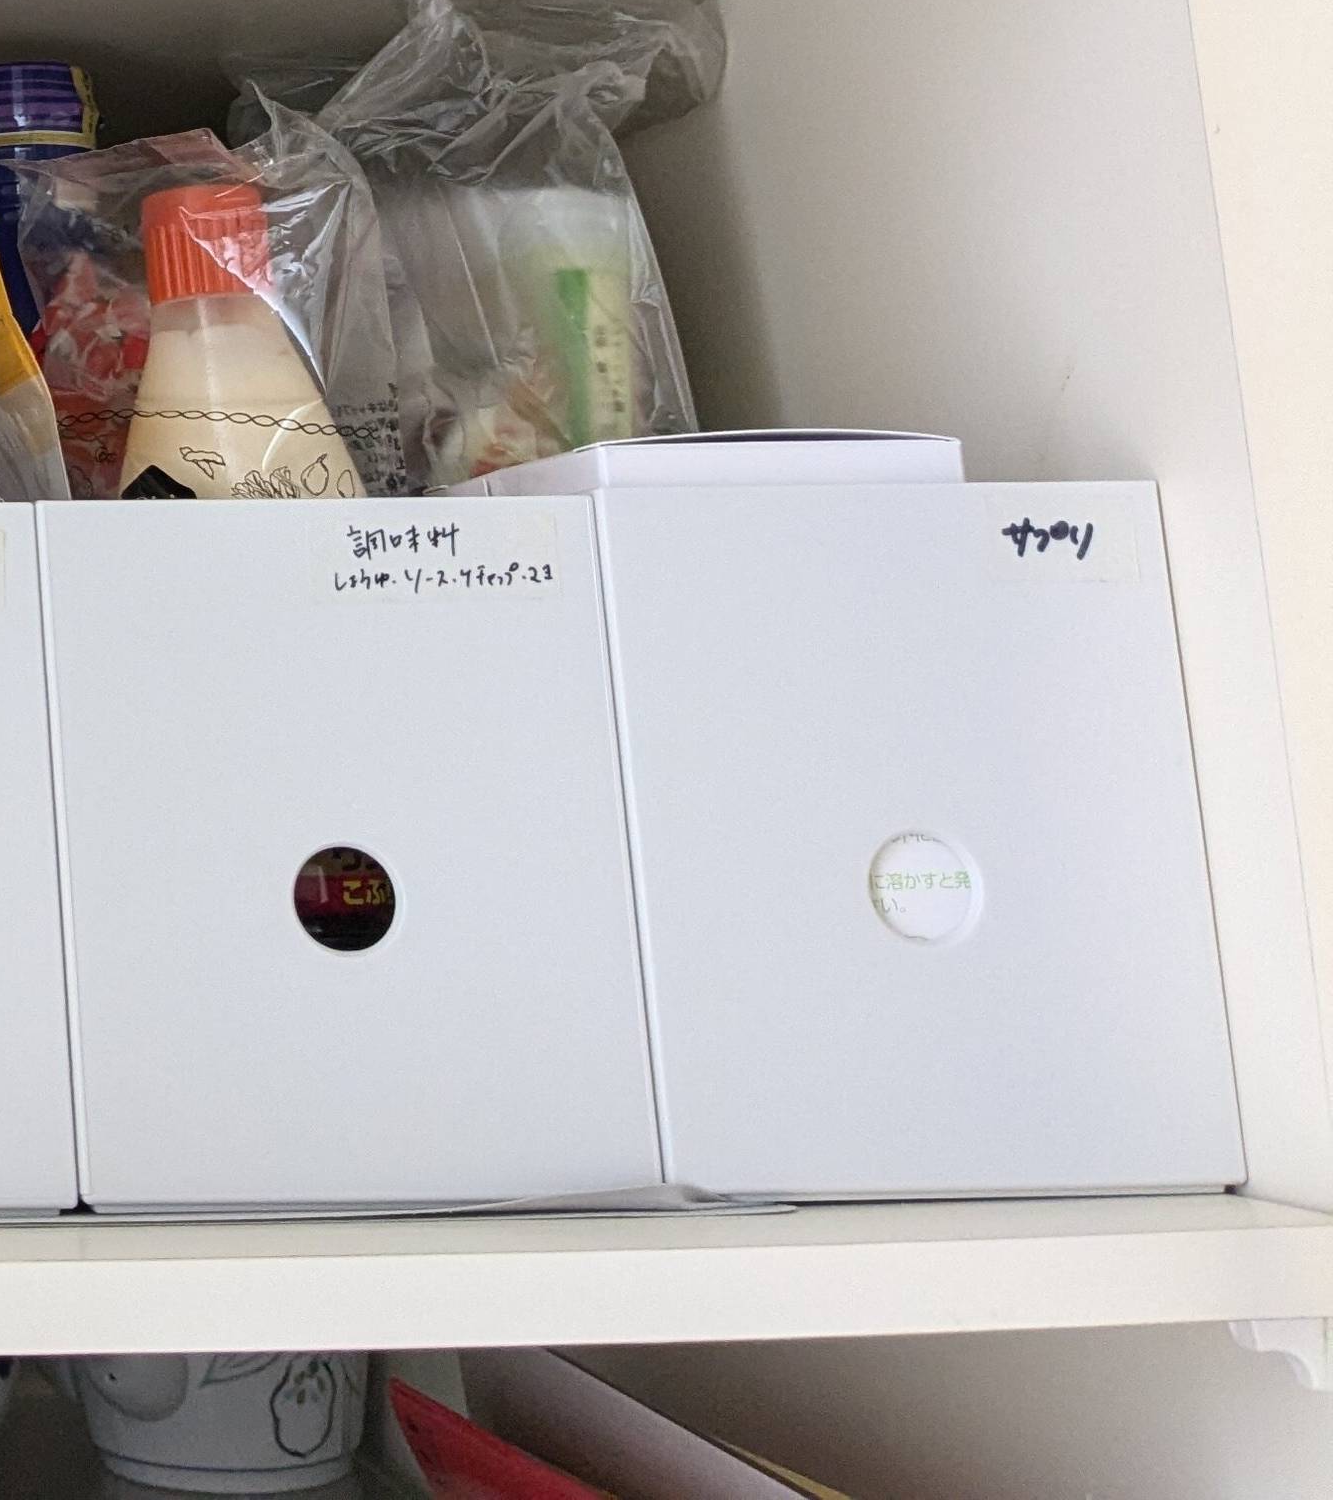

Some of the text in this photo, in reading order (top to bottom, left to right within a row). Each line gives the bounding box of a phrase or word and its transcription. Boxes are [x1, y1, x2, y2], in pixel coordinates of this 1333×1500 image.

[346, 522, 460, 560] 調味料
[1002, 517, 1093, 560] サプリ
